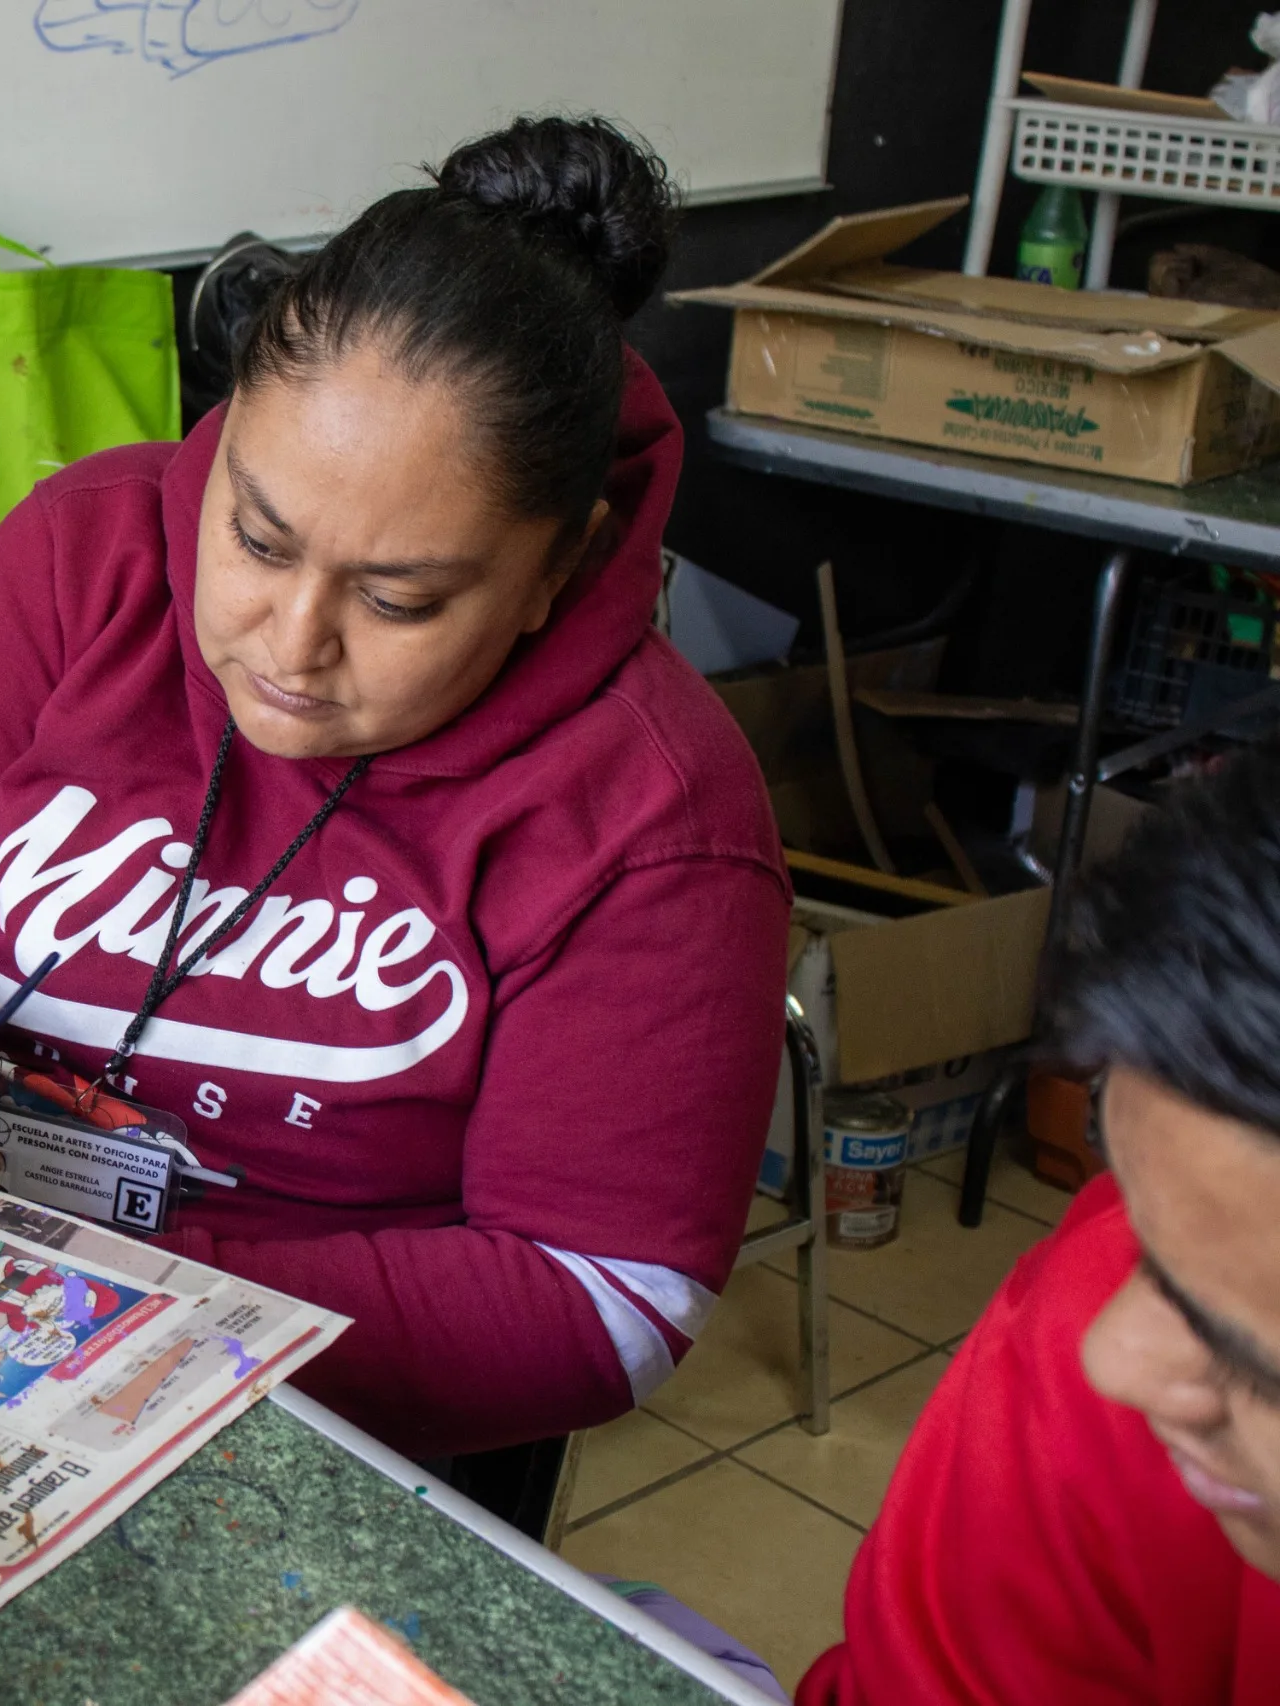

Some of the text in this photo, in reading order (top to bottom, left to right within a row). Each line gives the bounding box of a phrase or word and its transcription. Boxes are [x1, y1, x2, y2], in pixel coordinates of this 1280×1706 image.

[11, 1123, 167, 1170] ESCUELA DE ARTES Y OFICIOS PARA
[17, 1135, 159, 1179] PERSONAS CON DISCAPACIDAD
[847, 1140, 902, 1165] Sayer
[24, 1171, 113, 1200] CASTILLO BARRALLASCO
[40, 1164, 100, 1187] ANGIE ESTRELLA
[122, 1189, 152, 1222] E
[70, 1460, 92, 1478] El
[2, 1468, 70, 1513] zaguero
